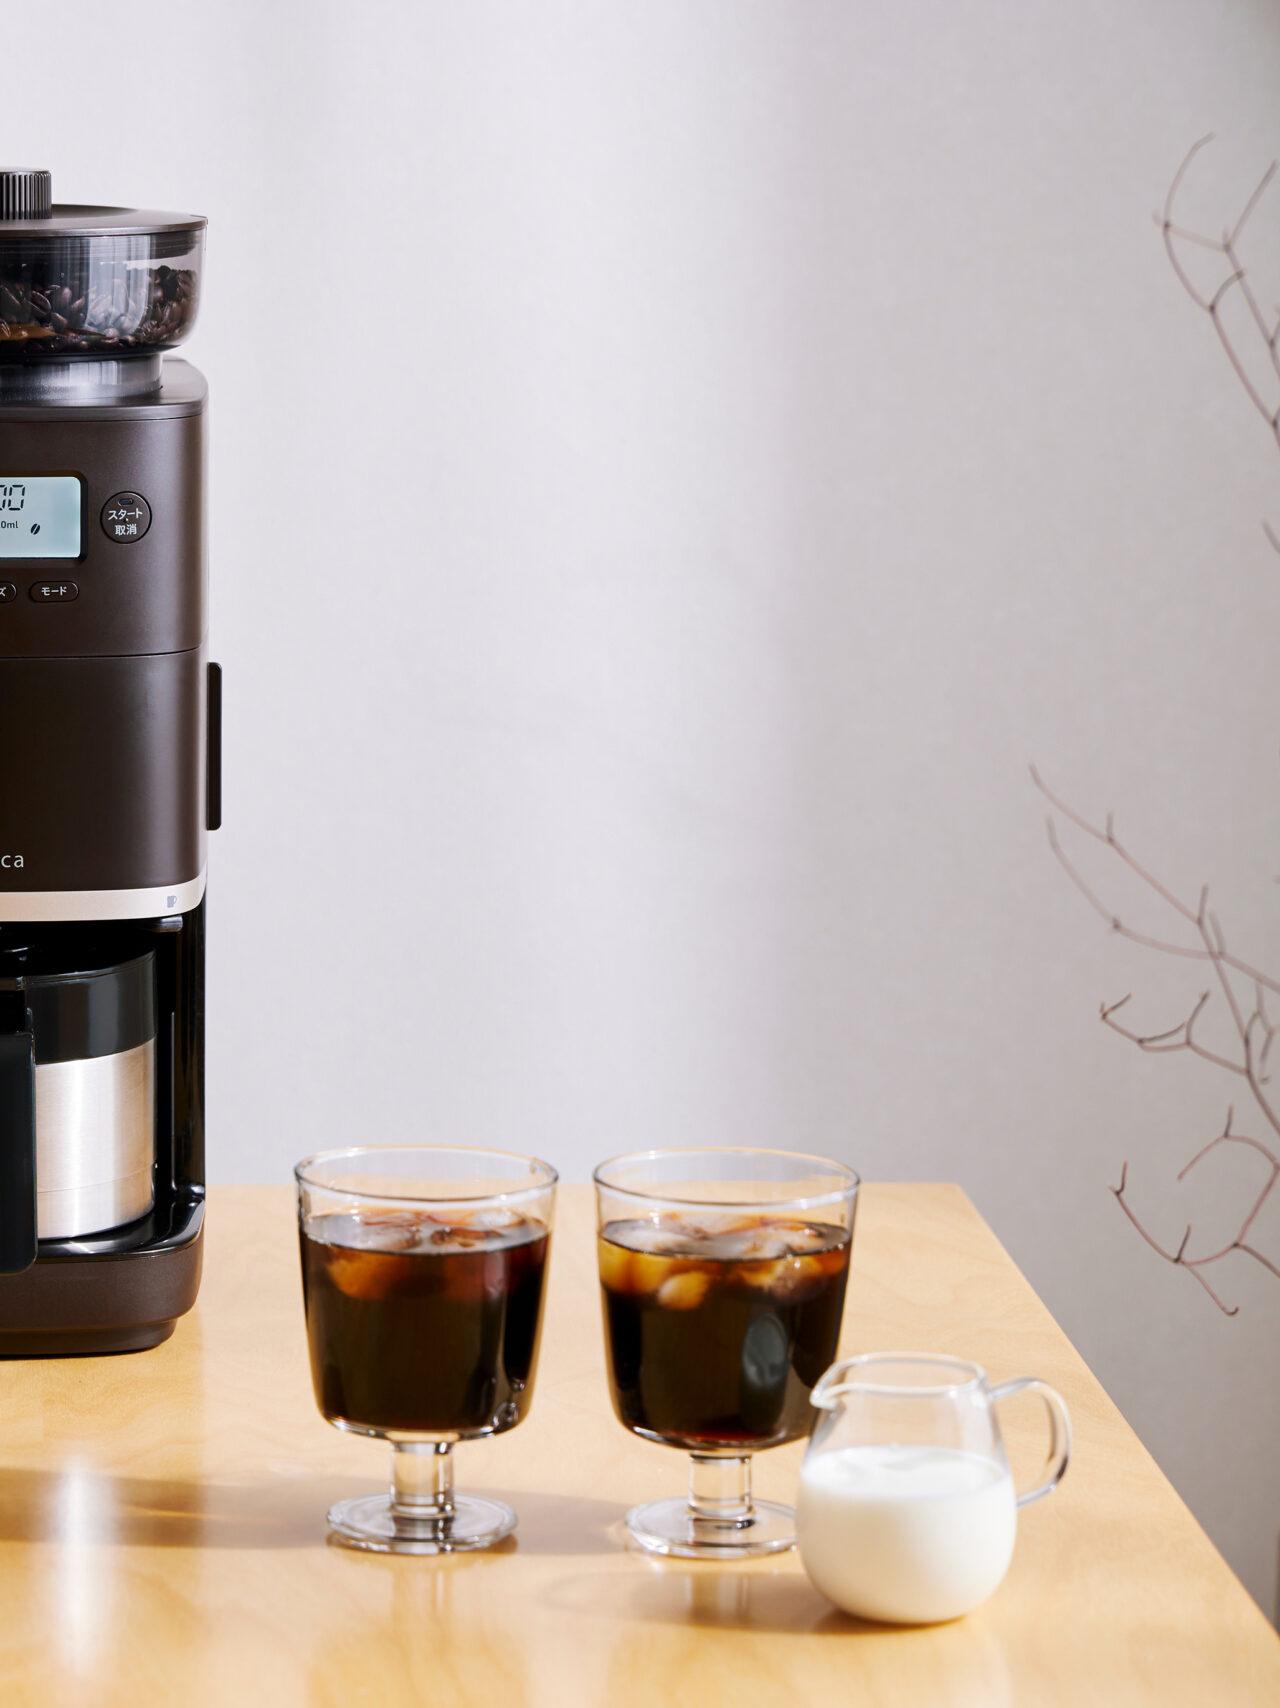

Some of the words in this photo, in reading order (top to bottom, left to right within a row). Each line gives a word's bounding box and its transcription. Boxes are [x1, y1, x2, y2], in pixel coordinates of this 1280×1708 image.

[107, 507, 144, 520] スタート
[114, 523, 138, 536] 取消
[40, 586, 67, 597] モード
